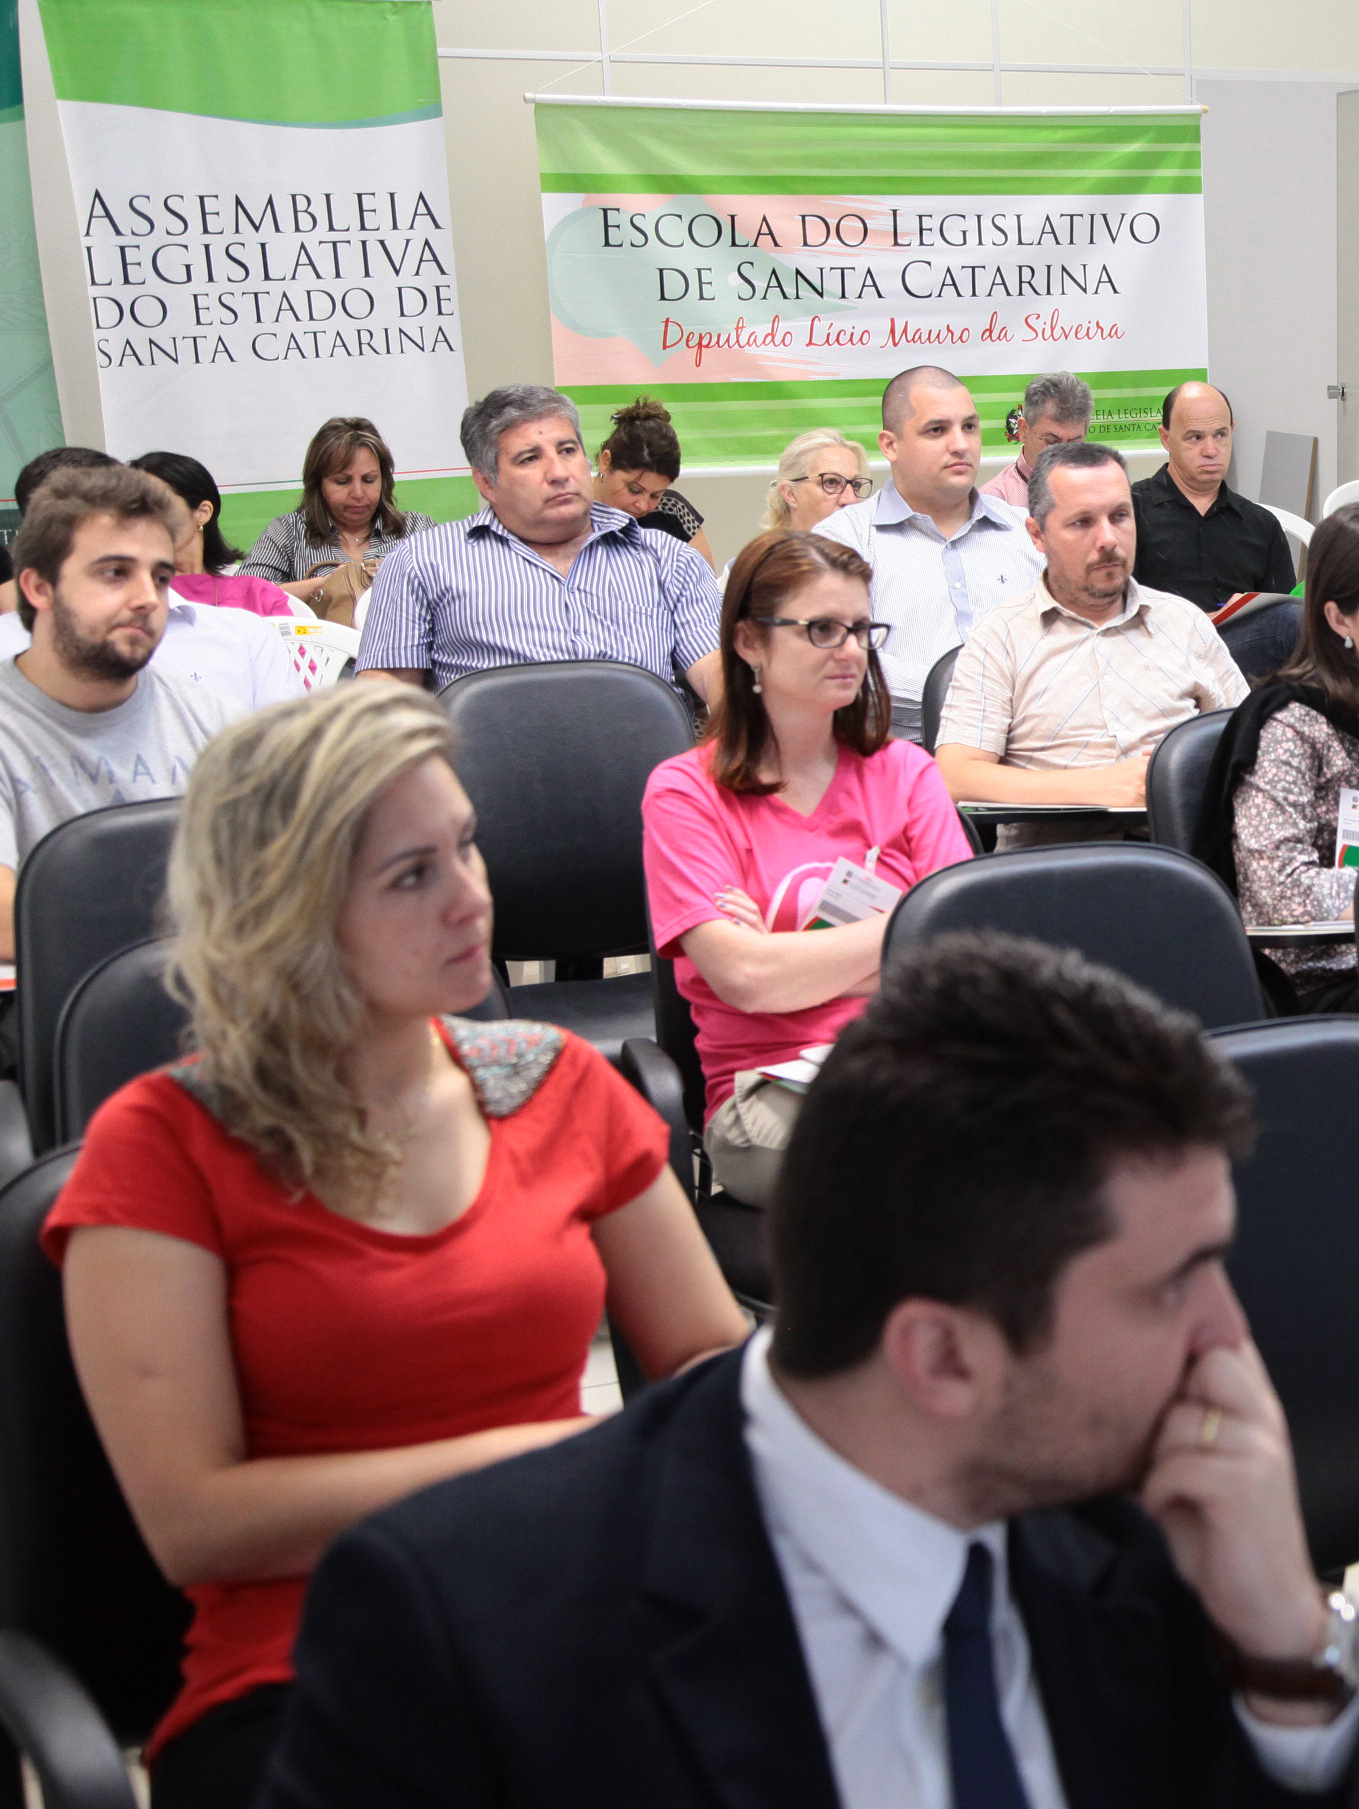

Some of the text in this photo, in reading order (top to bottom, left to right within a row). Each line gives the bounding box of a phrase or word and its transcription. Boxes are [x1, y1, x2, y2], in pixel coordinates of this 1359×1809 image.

[83, 188, 444, 238] ASSEMBLEIA
[599, 206, 1161, 249] ESCOLA DO LEGISLATIVO
[84, 237, 452, 287] LEGISLATIVA
[655, 260, 1120, 303] DE SANTA CATARINA
[93, 284, 455, 330] DO ESTADO DE
[97, 325, 456, 369] SANTA CATARINA
[661, 308, 1126, 368] Deputado Lício Mauro da Silveira
[1099, 424, 1111, 433] DE
[1114, 424, 1141, 433] SANTA
